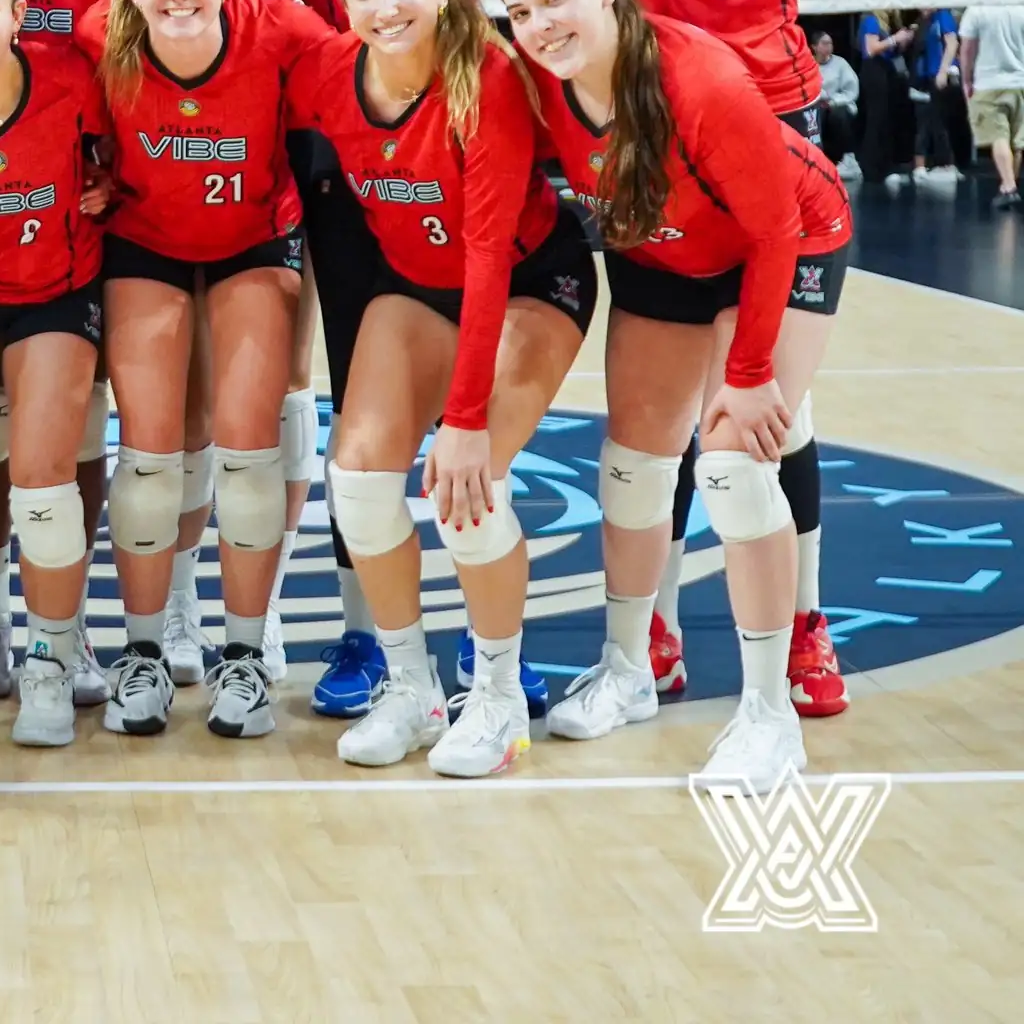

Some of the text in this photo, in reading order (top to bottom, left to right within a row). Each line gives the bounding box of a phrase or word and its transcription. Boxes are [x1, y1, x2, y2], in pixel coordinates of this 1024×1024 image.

[21, 7, 73, 33] BE
[158, 124, 222, 136] ATLANTA
[137, 131, 247, 162] VIBE
[204, 172, 243, 204] 21
[348, 172, 444, 204] VIBE
[422, 215, 449, 246] 3
